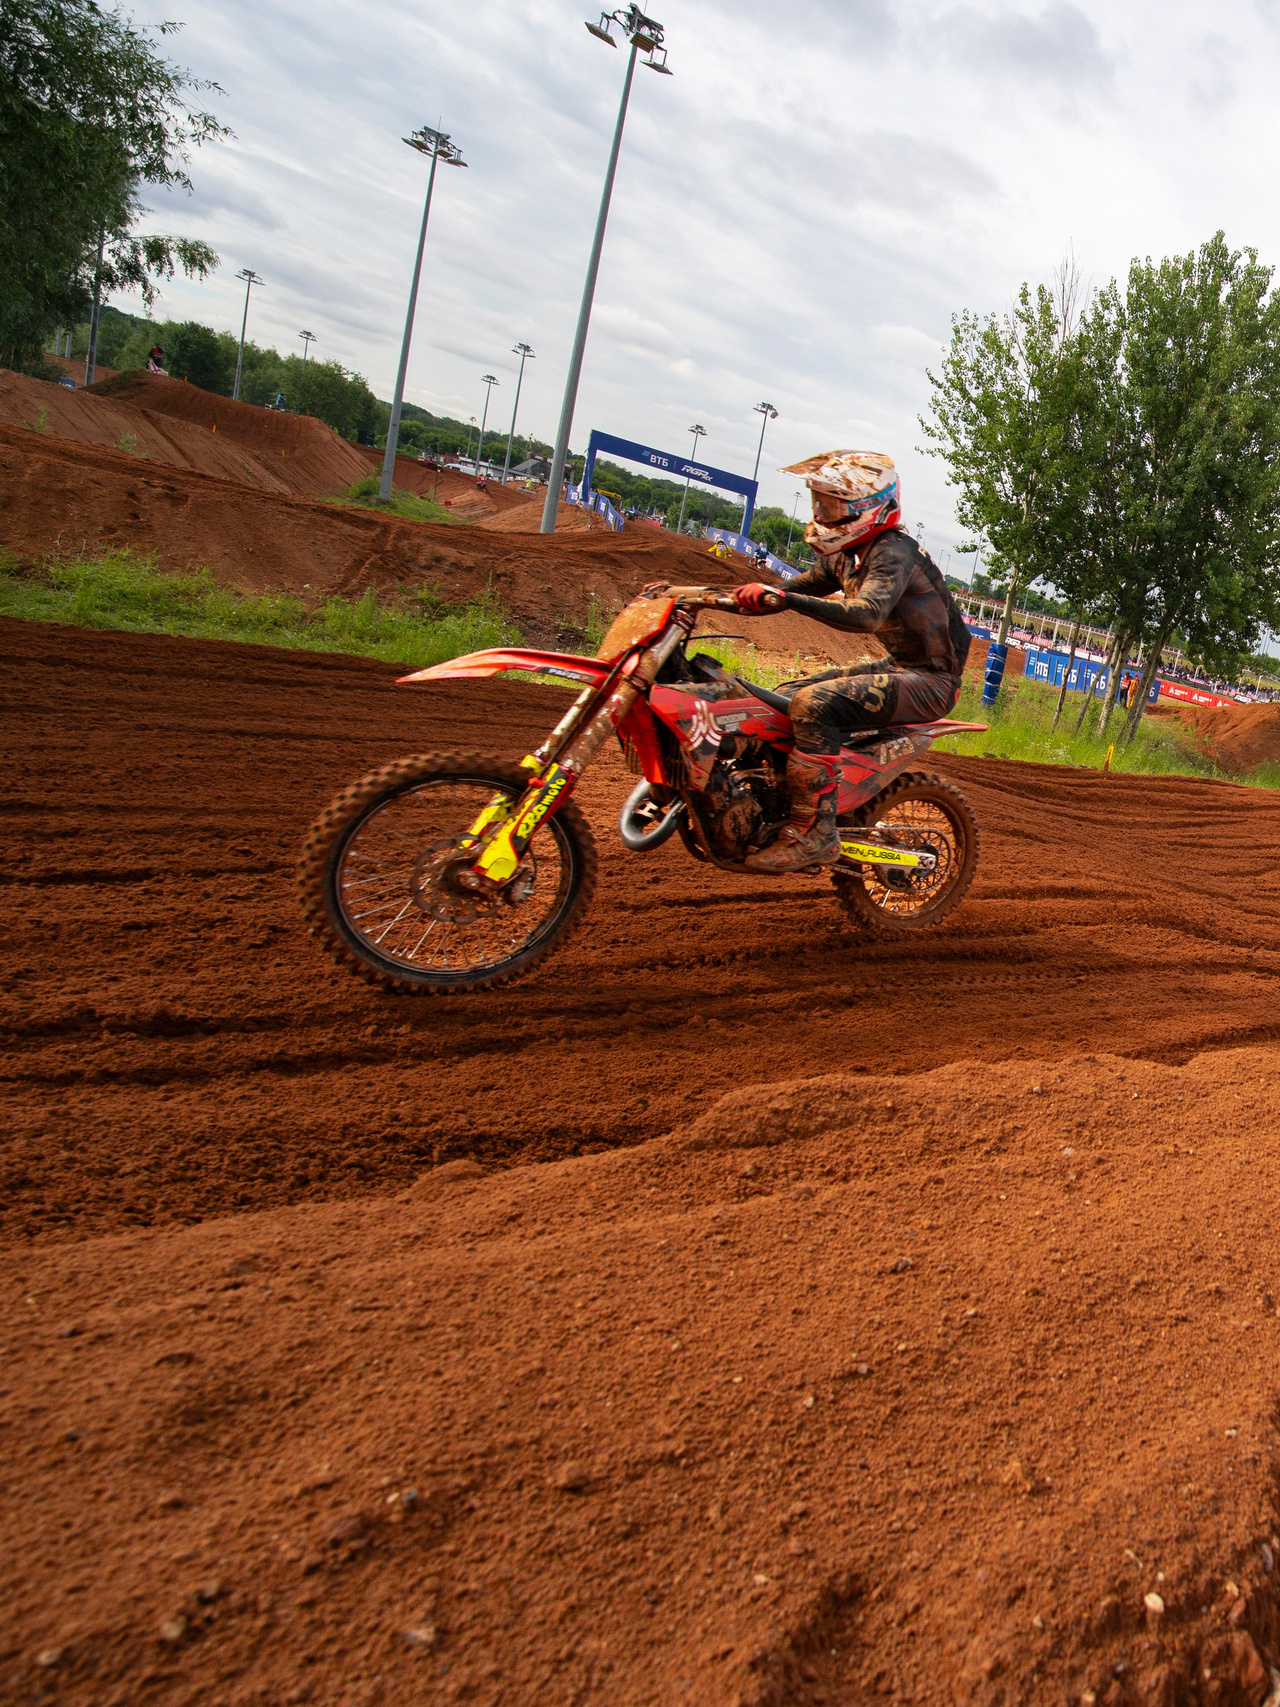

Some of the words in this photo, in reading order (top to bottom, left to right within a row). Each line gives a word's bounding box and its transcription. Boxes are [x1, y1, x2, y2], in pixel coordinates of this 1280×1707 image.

[650, 454, 669, 467] ВТБ
[681, 465, 709, 477] RGP
[840, 845, 901, 861] VEN_RUSSIA
